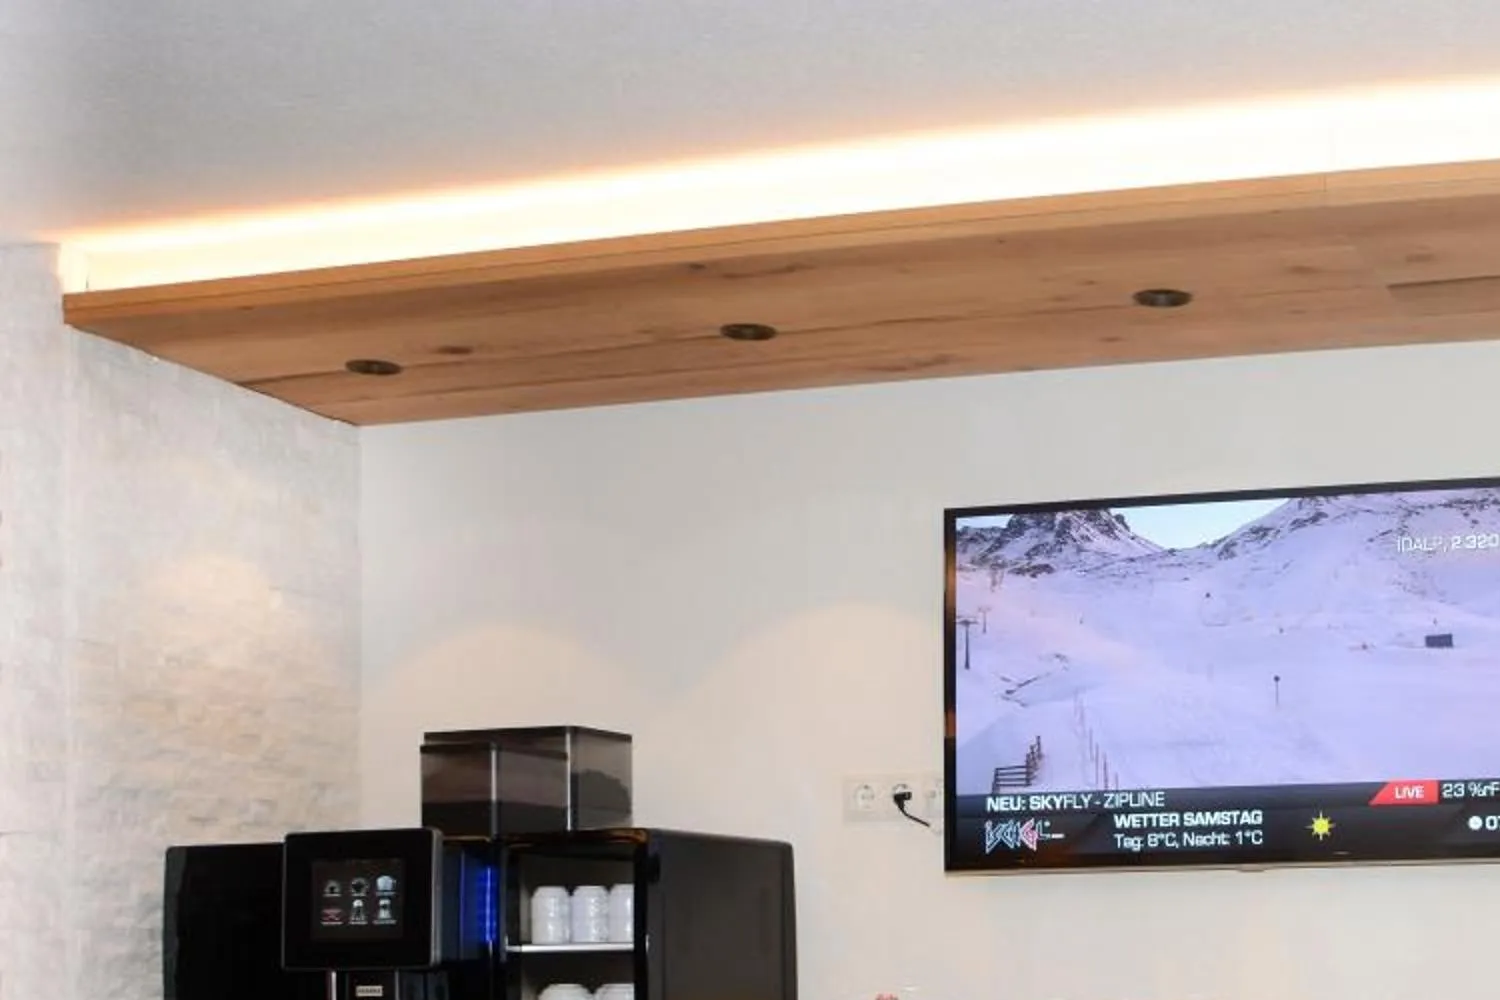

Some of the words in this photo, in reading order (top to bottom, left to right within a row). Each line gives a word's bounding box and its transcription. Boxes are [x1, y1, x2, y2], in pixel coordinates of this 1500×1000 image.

[1394, 785, 1424, 800] LIVE
[1442, 782, 1465, 798] 23
[986, 796, 1025, 812] NEU:
[1029, 793, 1092, 811] SKYFLY
[1103, 791, 1165, 809] ZIPLINE
[1113, 812, 1180, 829] WETTER
[1183, 809, 1263, 827] SAMSTAG
[1114, 833, 1144, 851] Tag:
[1183, 831, 1230, 847] Nacht:
